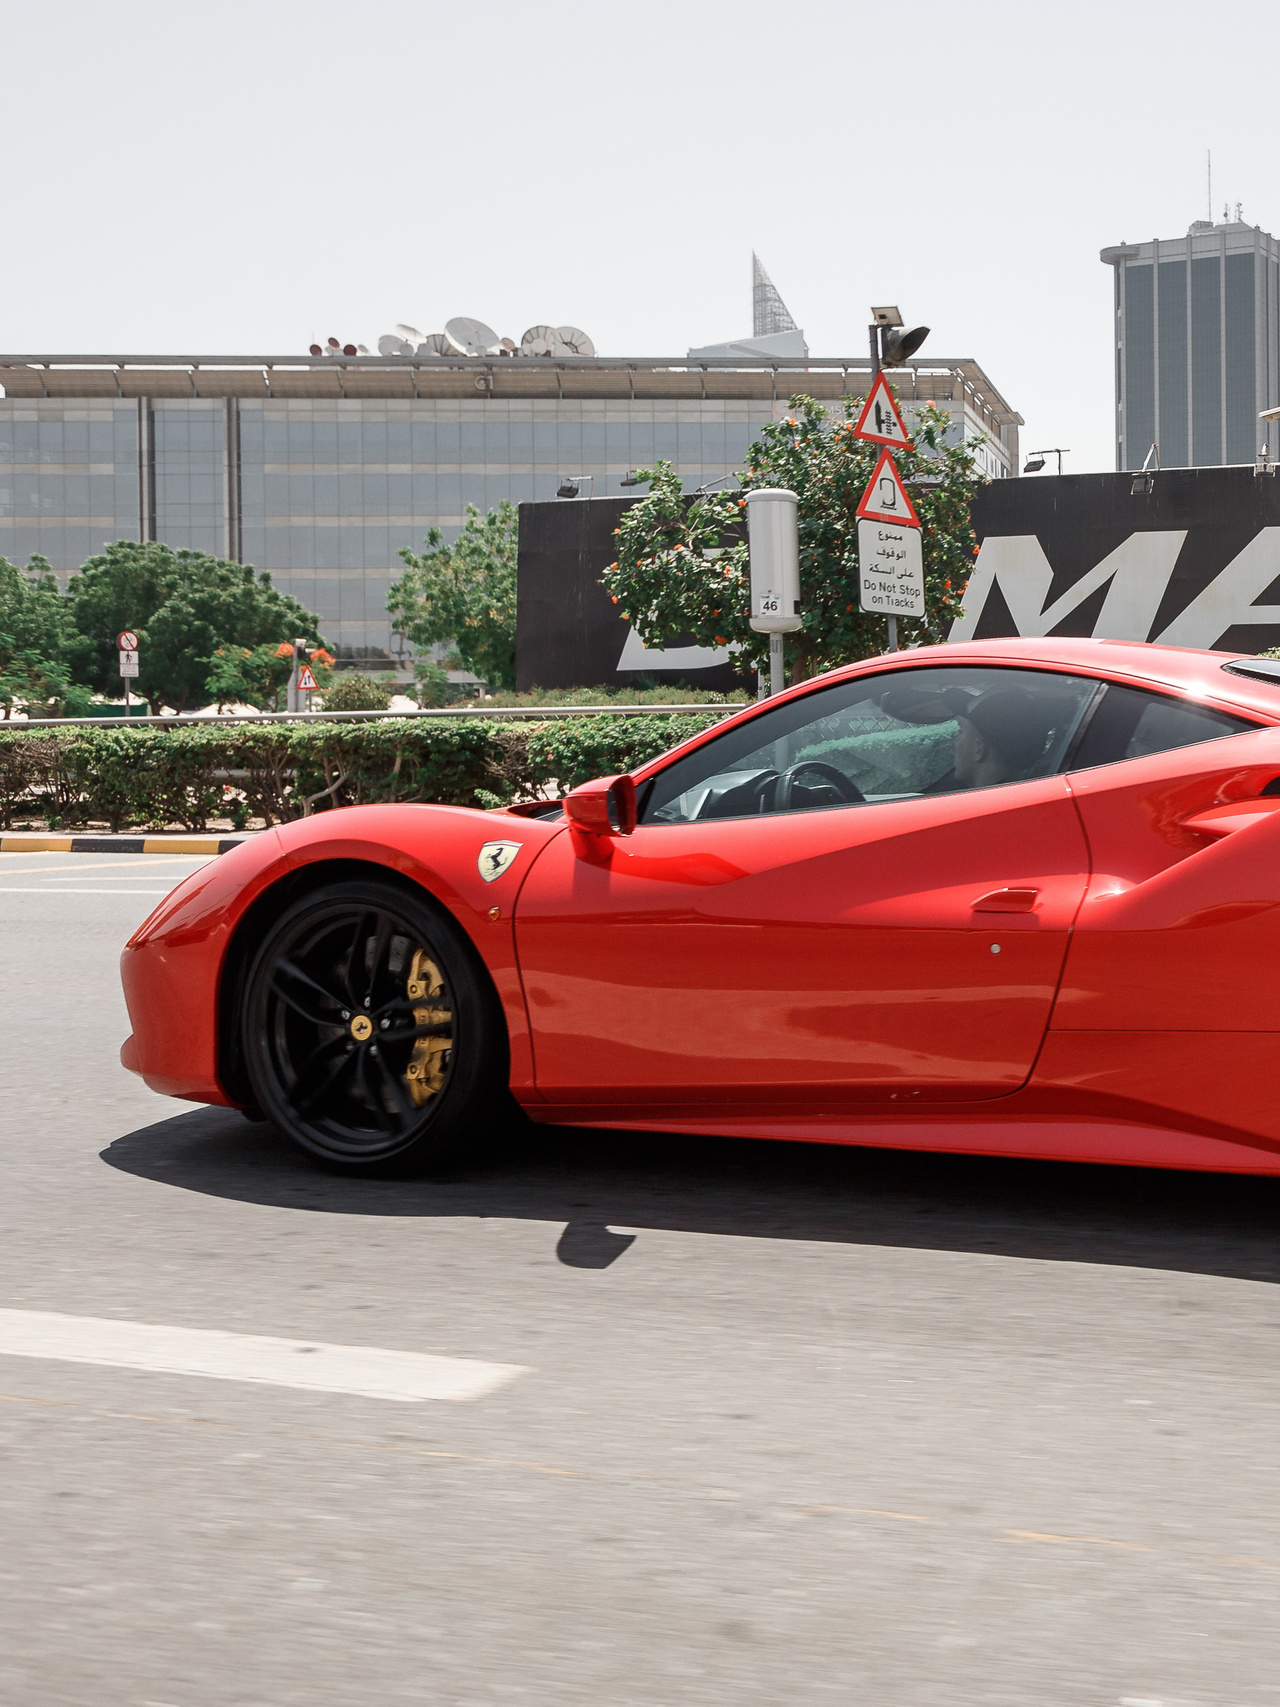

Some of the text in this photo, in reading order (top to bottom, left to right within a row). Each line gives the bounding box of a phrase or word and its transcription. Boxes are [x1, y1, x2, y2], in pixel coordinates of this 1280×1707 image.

[878, 530, 903, 541] ممنوع
[876, 546, 906, 560] الوقوف
[869, 563, 914, 579] على السكة
[863, 579, 921, 598] Do Not Stop
[762, 600, 778, 611] 46
[871, 595, 915, 609] on Tracks
